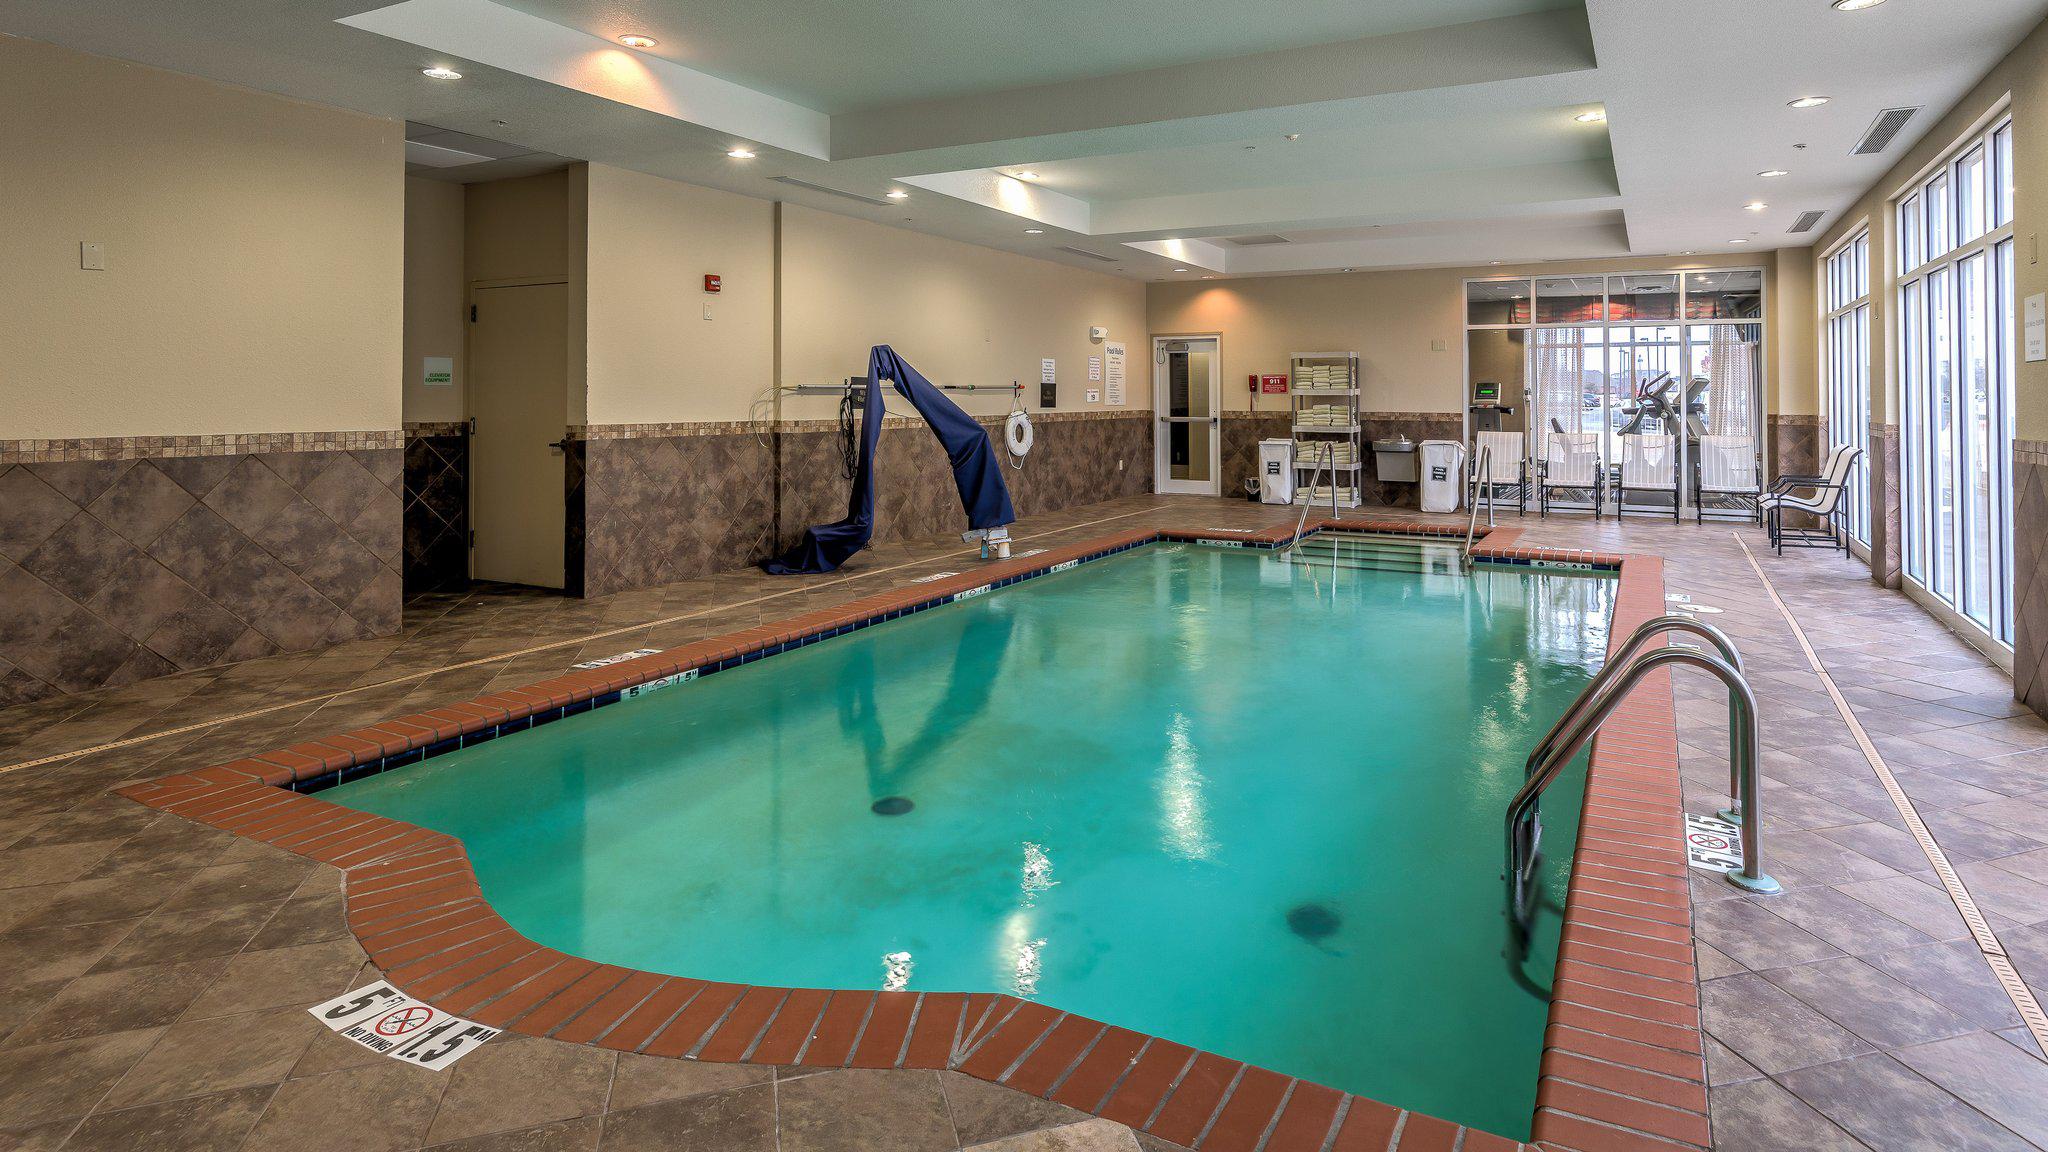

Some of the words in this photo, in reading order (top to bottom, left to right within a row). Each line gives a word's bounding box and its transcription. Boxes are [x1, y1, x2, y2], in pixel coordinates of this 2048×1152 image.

[629, 687, 640, 698] 5
[1691, 853, 1743, 868] 5
[324, 987, 396, 1019] 5
[382, 995, 406, 1008] FT
[344, 1026, 362, 1039] NO
[359, 1031, 394, 1052] DIVING
[397, 1020, 485, 1063] 1.5
[473, 1029, 497, 1042] M
